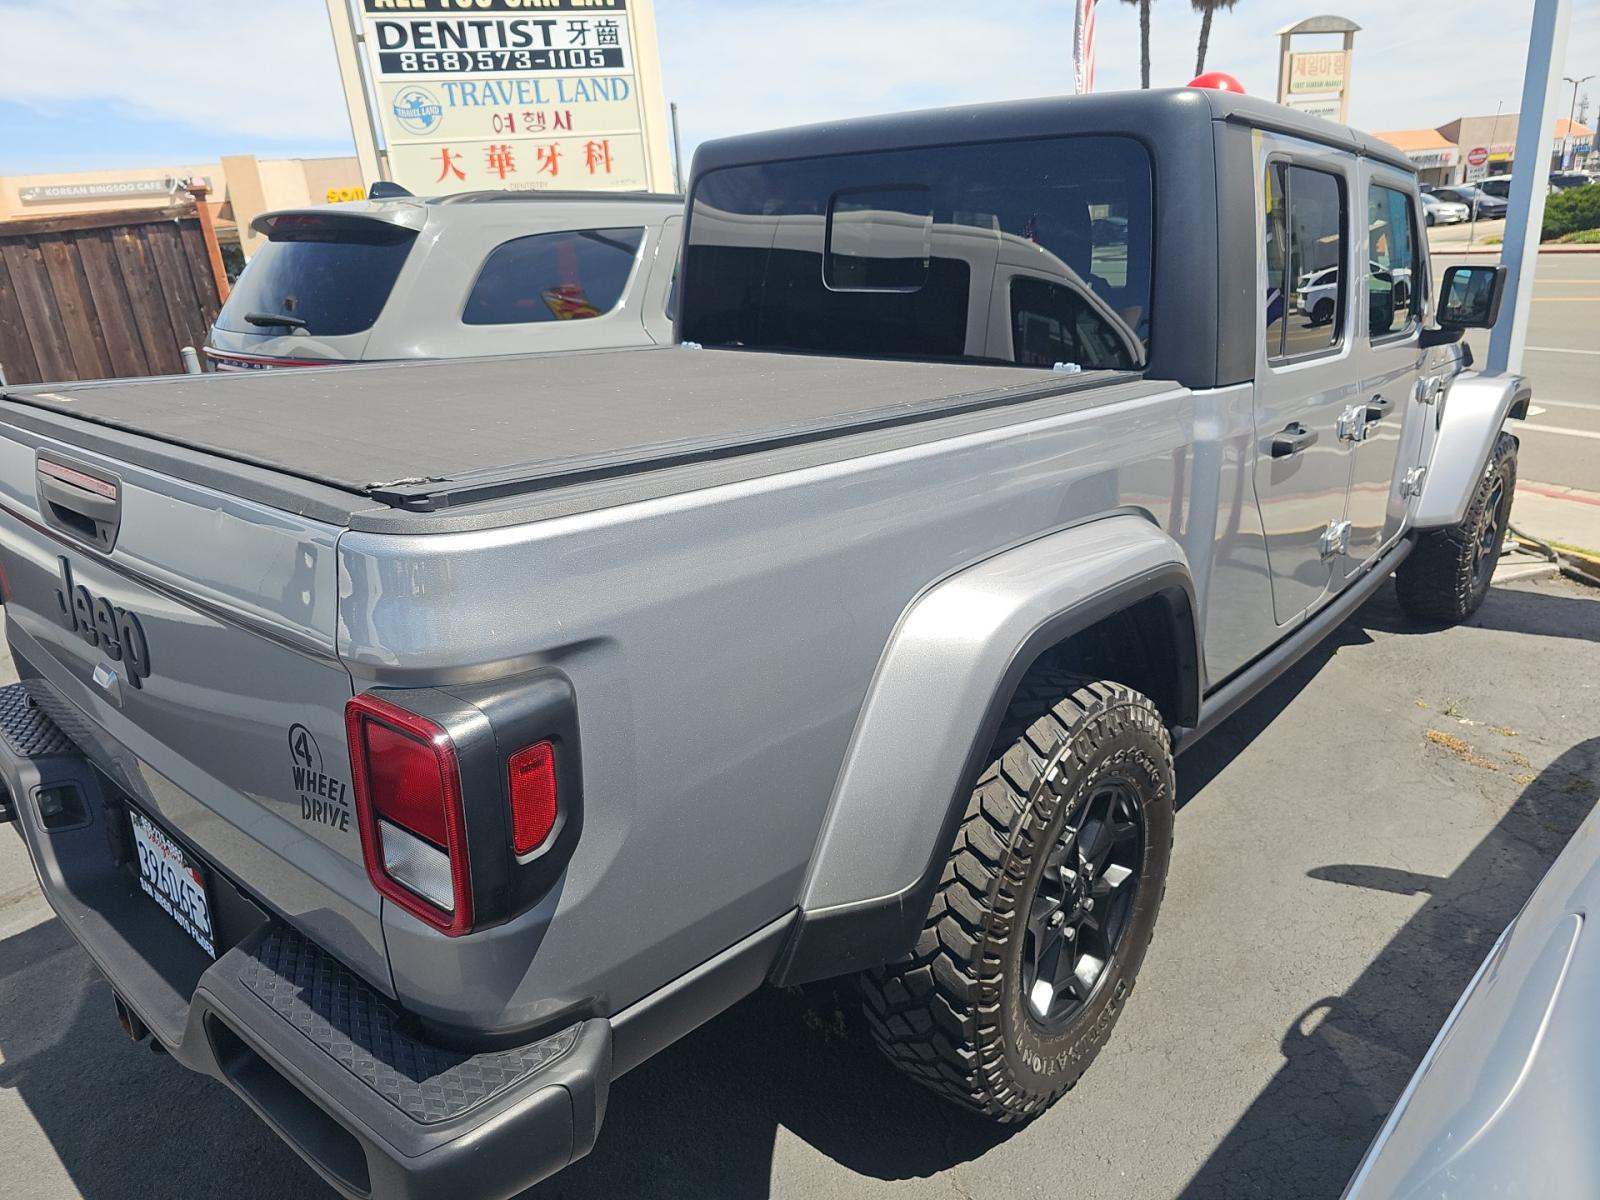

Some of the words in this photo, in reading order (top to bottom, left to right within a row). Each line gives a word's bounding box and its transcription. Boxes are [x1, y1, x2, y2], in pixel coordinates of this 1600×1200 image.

[376, 20, 557, 50] DENTIST
[566, 18, 620, 47] 牙齒
[400, 50, 605, 72] 858)573-1105
[441, 79, 550, 107] TRAVEL
[558, 77, 630, 103] LAND
[492, 109, 573, 134] 여행사
[430, 139, 615, 183] 大華牙科
[45, 186, 87, 197] KOREAN
[89, 183, 135, 194] BINGSOO
[137, 181, 162, 191] CAFE
[54, 555, 151, 690] Jeep
[295, 732, 312, 768] 4
[292, 766, 348, 807] WHEEL
[301, 794, 350, 832] DRIVE
[138, 841, 211, 938] 39606F3
